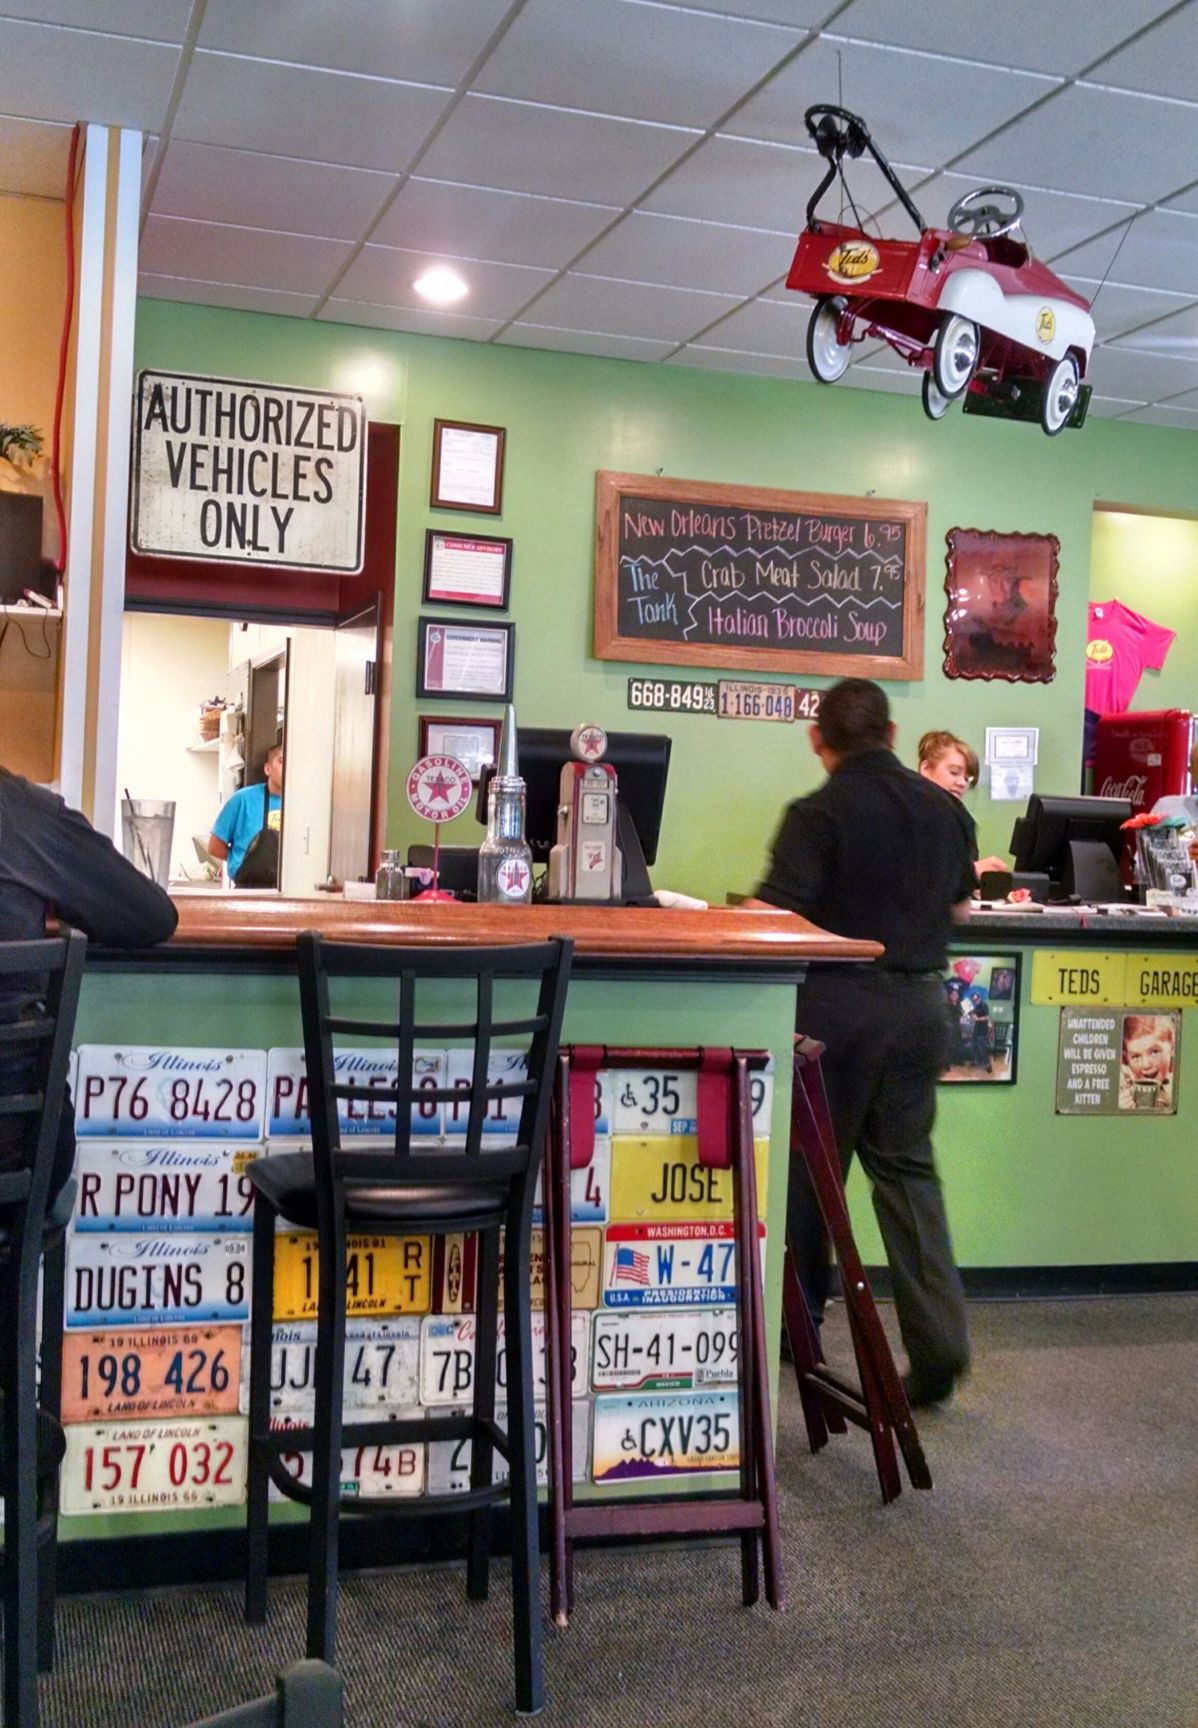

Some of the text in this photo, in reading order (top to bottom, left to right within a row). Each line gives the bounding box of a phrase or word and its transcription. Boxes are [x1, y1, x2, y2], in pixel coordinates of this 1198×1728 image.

[144, 383, 358, 453] AUTHORIZED
[165, 440, 334, 504] VEHICLES
[200, 499, 294, 554] ONLY
[625, 513, 665, 540] New
[671, 510, 736, 540] Orleans
[740, 513, 800, 542] Pretzel
[805, 519, 855, 551] Burger
[623, 563, 659, 592] The
[701, 561, 746, 588] Crab
[755, 562, 800, 588] Meat
[808, 562, 861, 592] Salad
[627, 593, 678, 625] Tank
[708, 607, 887, 646] Italian Broccoli Soup
[412, 758, 469, 784] GASOLINE
[411, 793, 467, 819] MOTOR OIL
[1058, 968, 1100, 994] TEDS
[1140, 971, 1198, 997] GARAGE
[1067, 1018, 1116, 1030] UNATTENDED
[1072, 1033, 1109, 1045] CHILDREN
[124, 1051, 223, 1073] Illinois
[335, 1053, 398, 1072] Illinoi
[1064, 1047, 1116, 1060] WILL BE GIVEN
[1072, 1063, 1107, 1075] ESPRESSO
[641, 1075, 680, 1115] 35
[1066, 1078, 1110, 1090] AND A FREE
[83, 1076, 257, 1122] P76 8428
[1075, 1093, 1101, 1105] KITTEN
[672, 1121, 688, 1132] SEP
[120, 1148, 219, 1168] Illinois
[80, 1172, 256, 1217] R PONY 19
[651, 1163, 722, 1203] JOSE
[108, 1240, 209, 1258] Illinois
[74, 1261, 245, 1312] DUGINS 8
[129, 1334, 178, 1347] ILLINOIS
[80, 1349, 230, 1400] 198 426
[107, 1401, 137, 1413] LAND
[151, 1398, 197, 1410] LINCOLN
[638, 1396, 715, 1408] ARIZONA
[113, 1427, 201, 1441] LAND OF LINCOLN
[640, 1413, 730, 1458] CXV35
[84, 1444, 146, 1492] 157
[169, 1441, 235, 1487] 032
[129, 1492, 178, 1504] ILLINOIS
